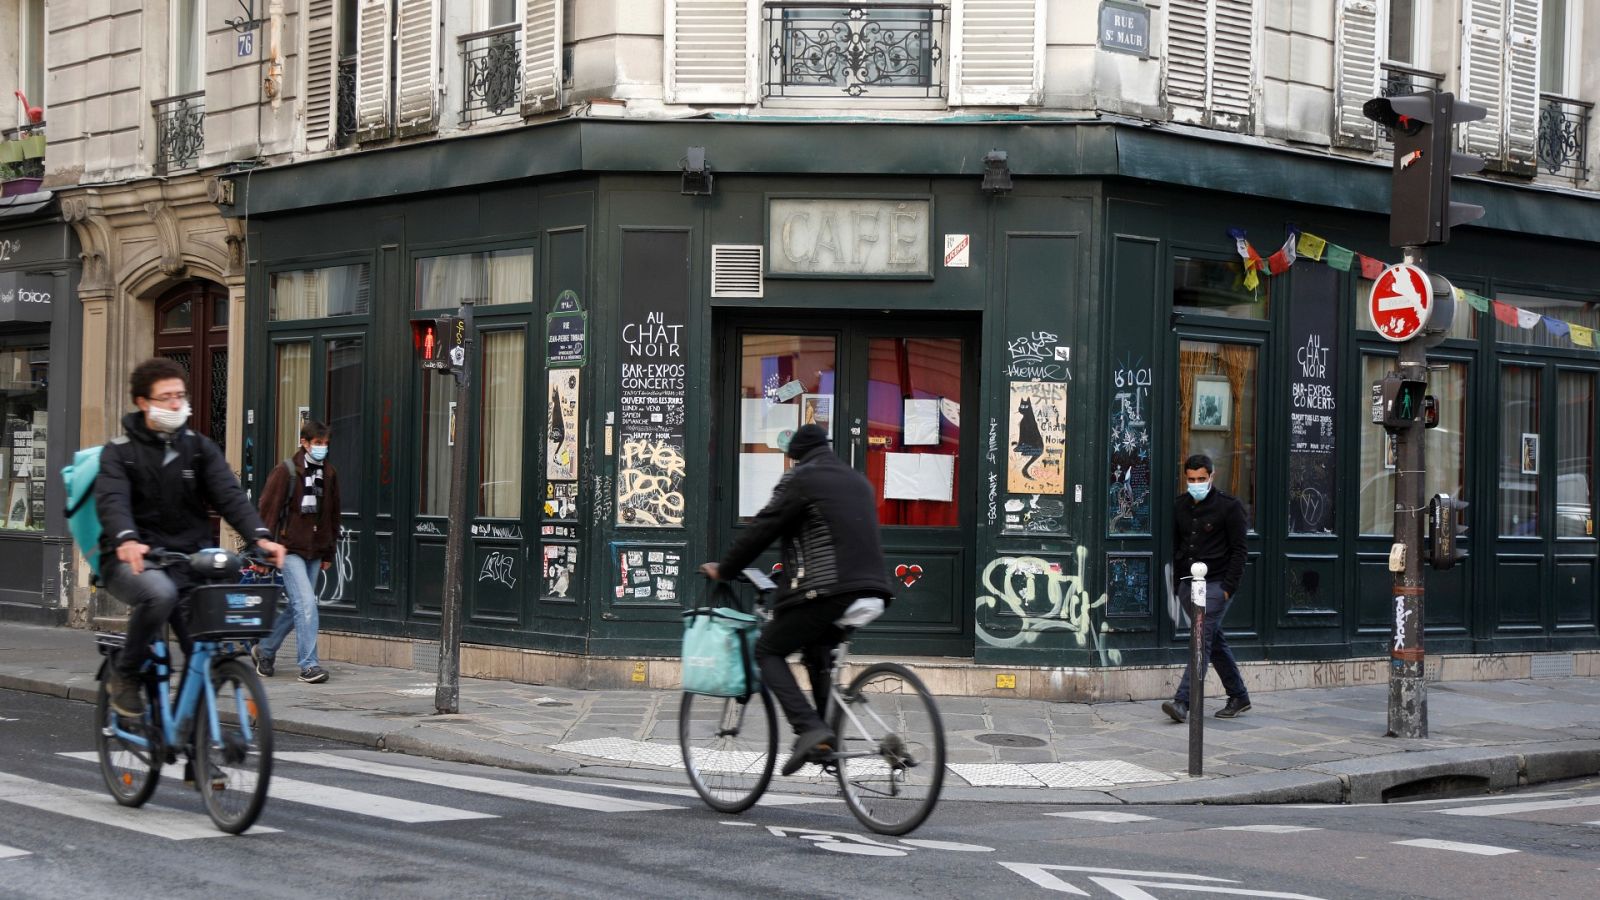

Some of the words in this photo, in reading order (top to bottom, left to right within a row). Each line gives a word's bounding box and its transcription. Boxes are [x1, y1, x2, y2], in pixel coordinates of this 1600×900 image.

[1114, 15, 1134, 28] RUE
[239, 35, 252, 55] 76
[1117, 31, 1142, 46] MAUR
[647, 312, 663, 324] AU
[622, 323, 684, 344] CHAT
[1307, 334, 1320, 348] AU
[630, 342, 680, 357] NOIR
[1297, 347, 1329, 366] CHAT
[621, 363, 686, 378] BAR-EXPOS
[1302, 363, 1326, 379] NOIR
[621, 378, 685, 390] CONCERTS
[1292, 383, 1332, 397] BAR-EXPOS
[621, 396, 646, 405] OUVERT
[646, 396, 659, 405] TOUS
[1293, 396, 1336, 410] CONCERTS
